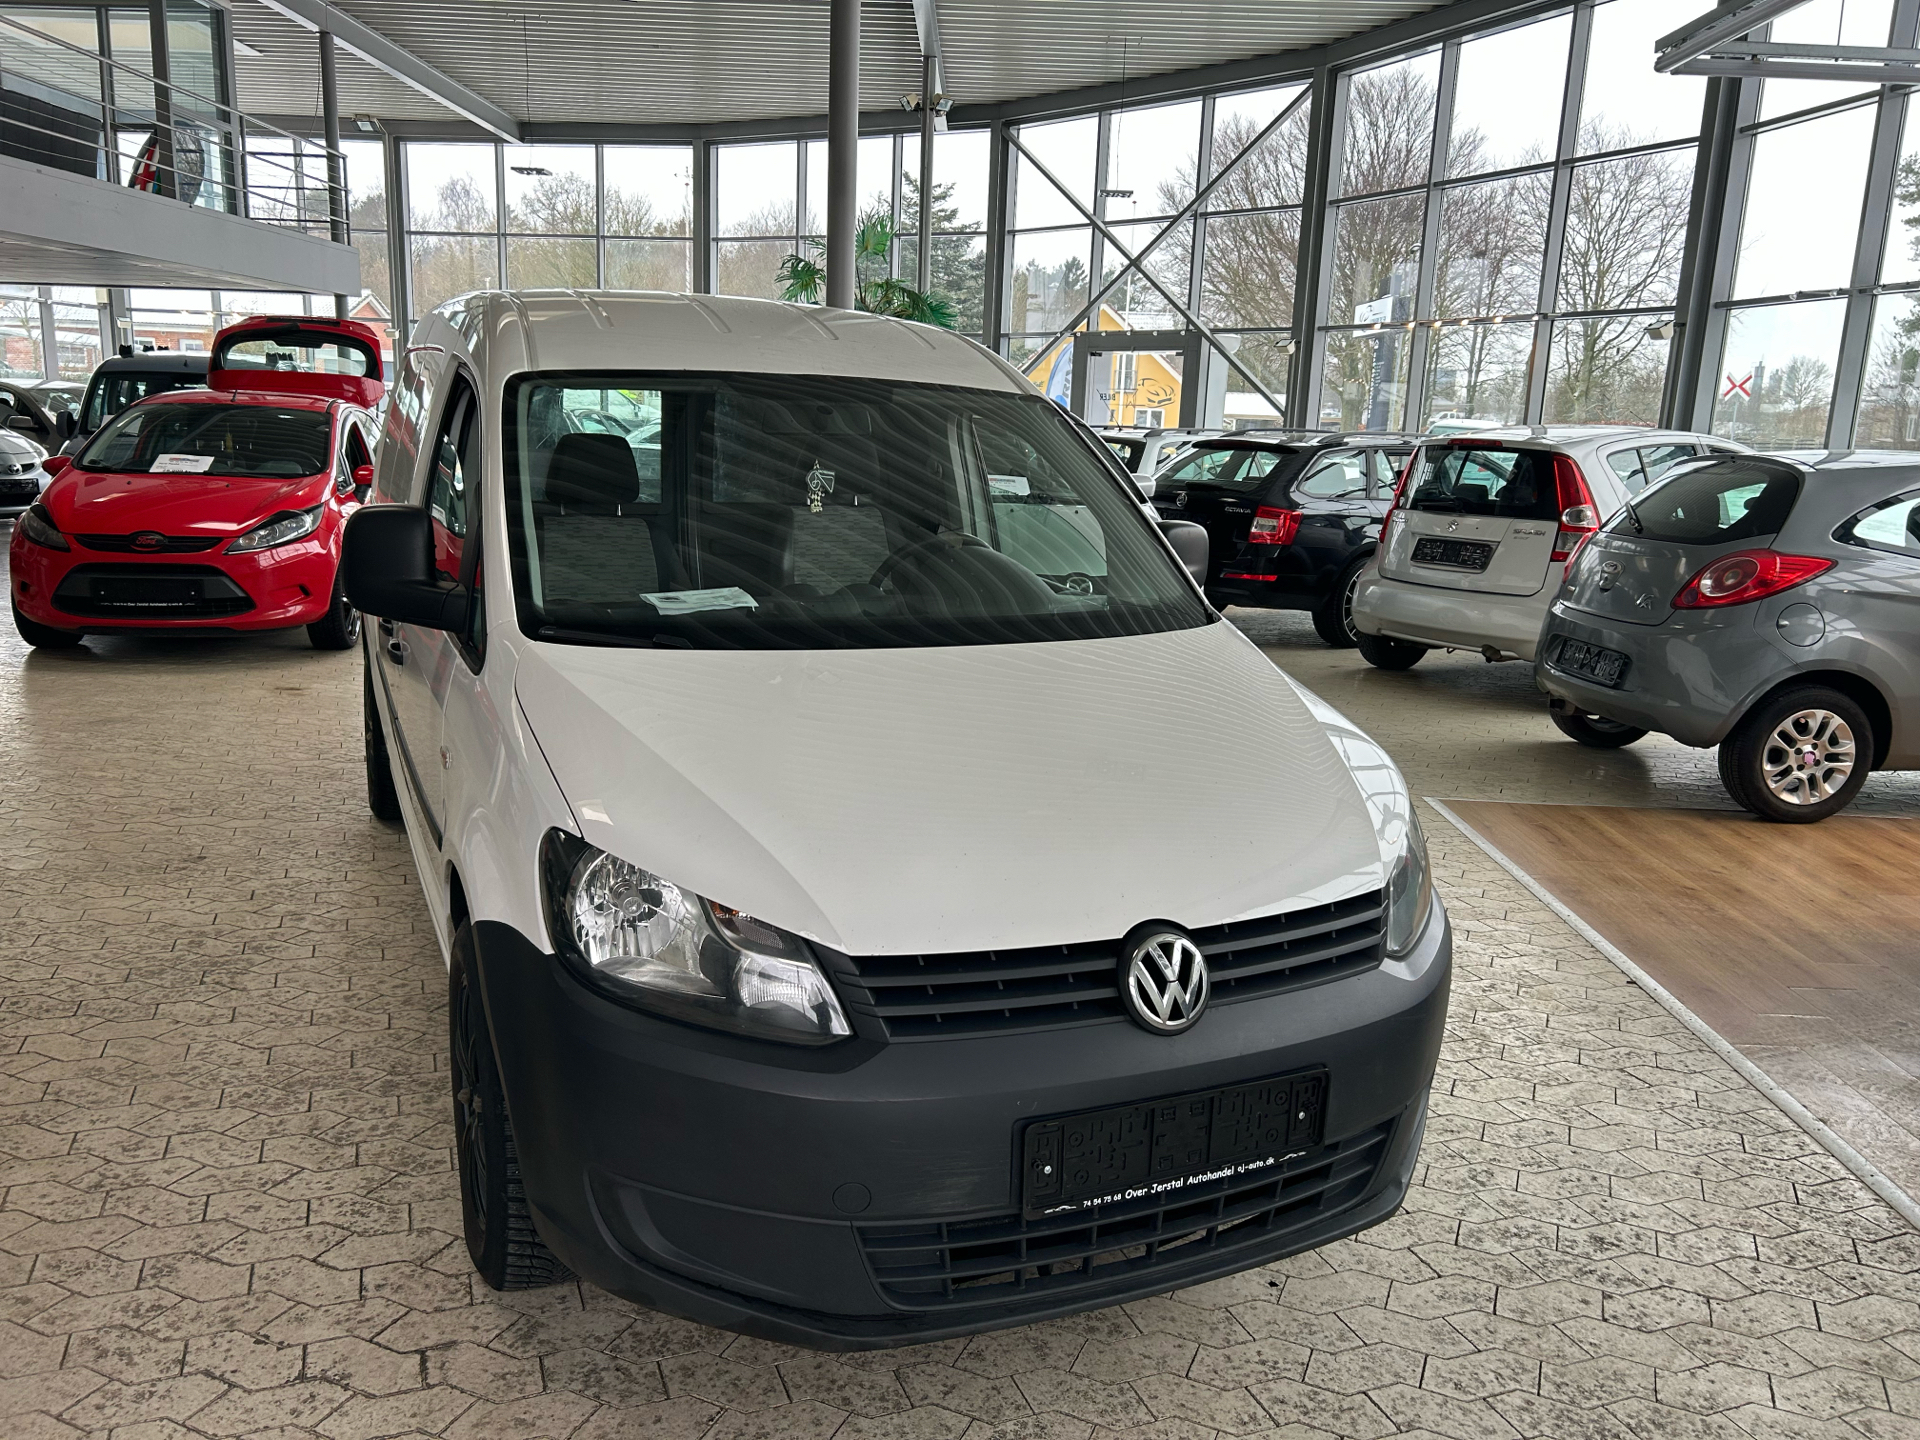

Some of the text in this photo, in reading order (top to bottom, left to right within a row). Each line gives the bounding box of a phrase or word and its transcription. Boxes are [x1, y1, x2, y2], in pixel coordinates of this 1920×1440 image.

[1225, 506, 1251, 514] OCTAVIA
[136, 536, 157, 545] Ford
[1131, 936, 1204, 1027] VW
[1083, 1199, 1091, 1208] 74
[1093, 1198, 1101, 1206] 54
[1113, 1193, 1122, 1201] 68
[1125, 1188, 1148, 1199] Over
[1150, 1177, 1184, 1194] Jerstal
[1187, 1165, 1235, 1186] Autohandel
[1237, 1156, 1275, 1174] oj-auto.dk
